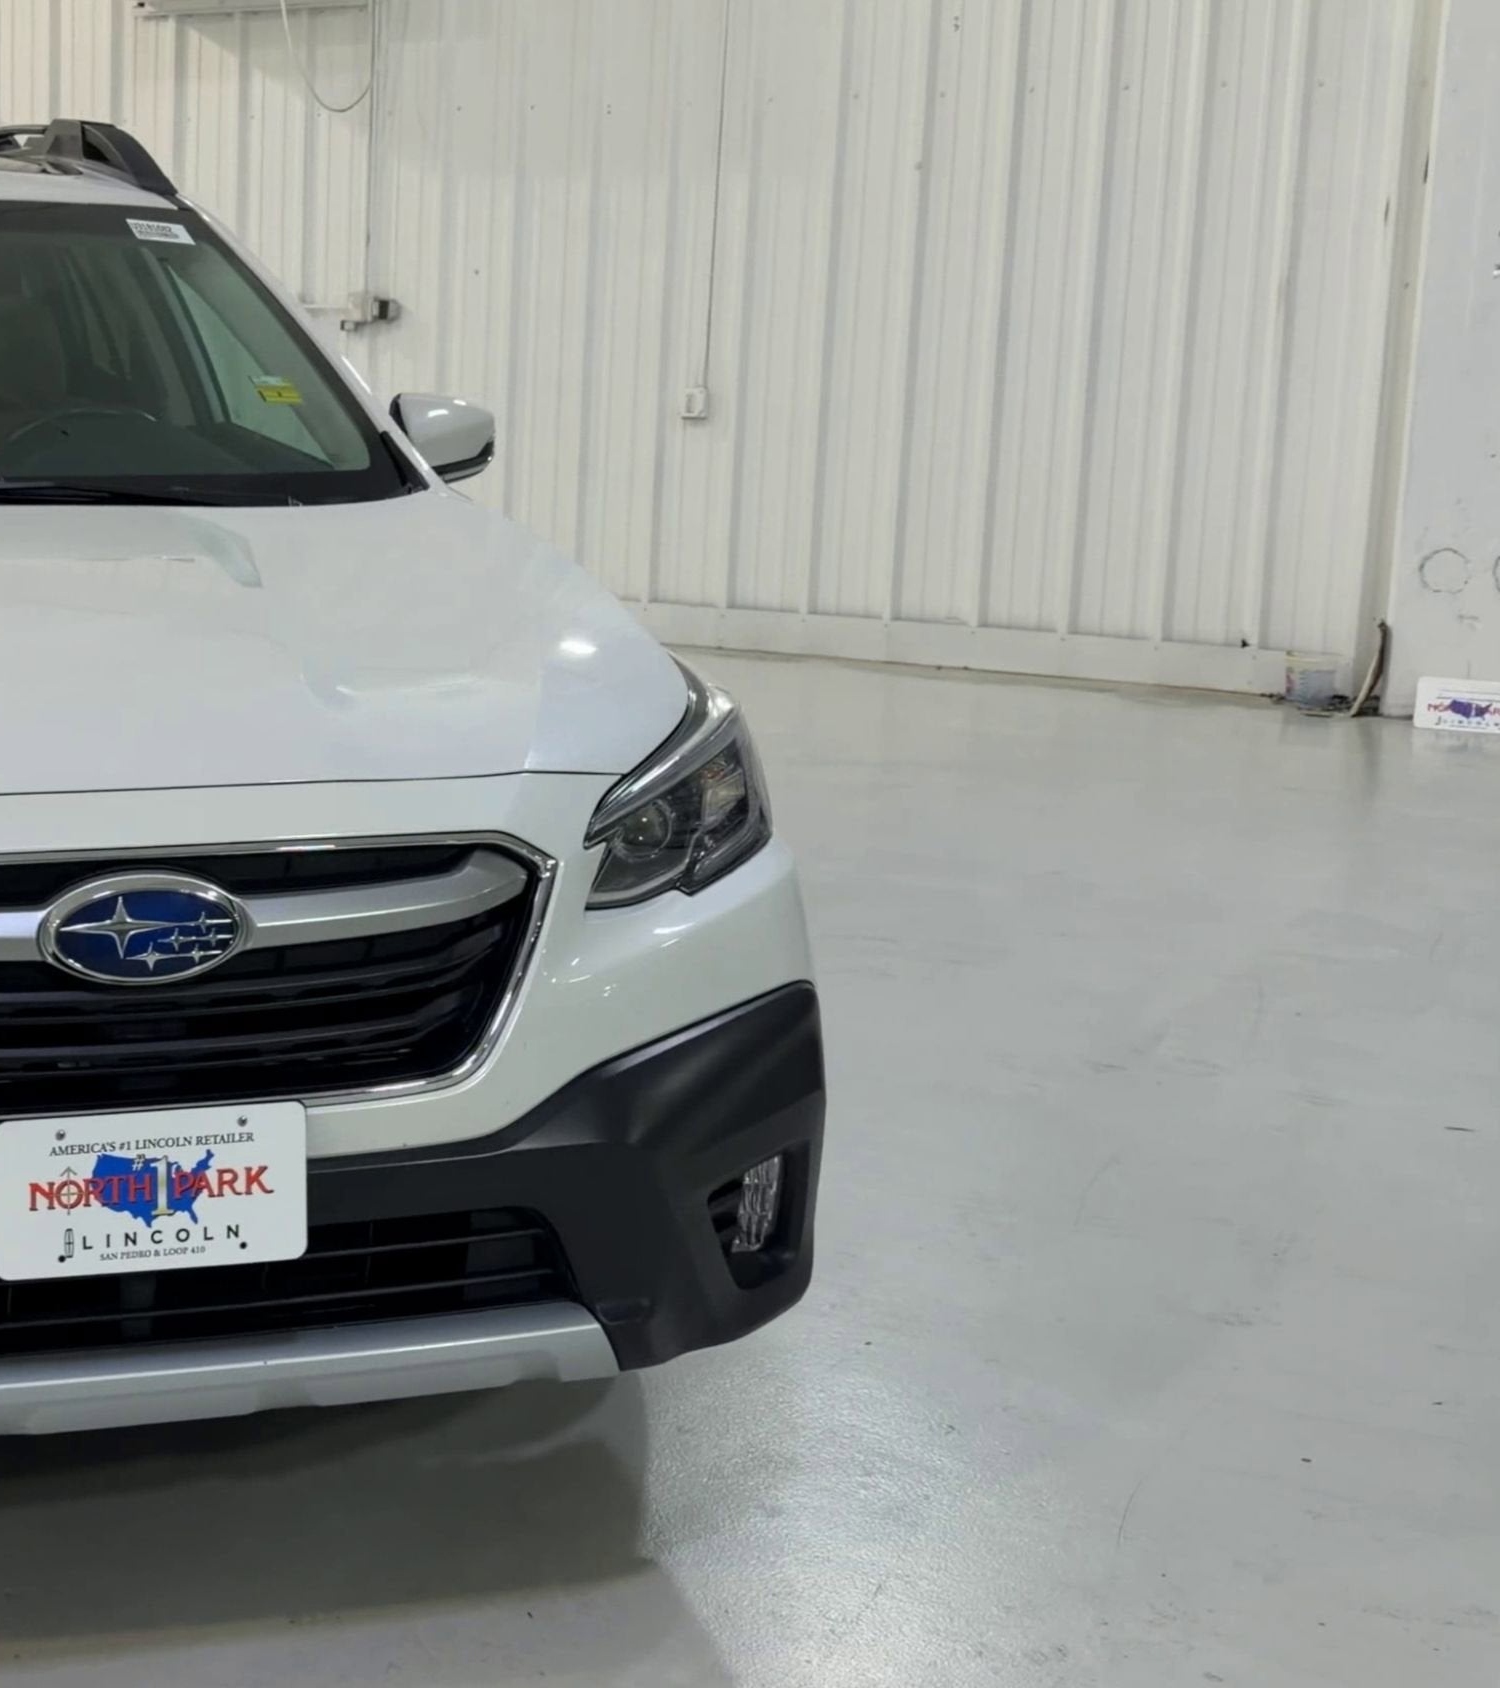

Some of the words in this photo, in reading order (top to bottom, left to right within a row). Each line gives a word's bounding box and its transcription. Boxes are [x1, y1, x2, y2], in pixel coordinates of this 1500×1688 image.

[50, 1140, 116, 1157] AMERICA'S
[119, 1140, 131, 1152] #1
[135, 1135, 193, 1150] LINCOLN
[196, 1131, 255, 1146] RETAILER
[28, 1173, 154, 1212] NORTH
[173, 1164, 275, 1200] PARK
[81, 1223, 240, 1251] LINCOLN
[100, 1252, 119, 1261] SAN
[120, 1249, 152, 1260] PEDRO
[153, 1249, 162, 1258] &
[163, 1247, 189, 1257] LOOP
